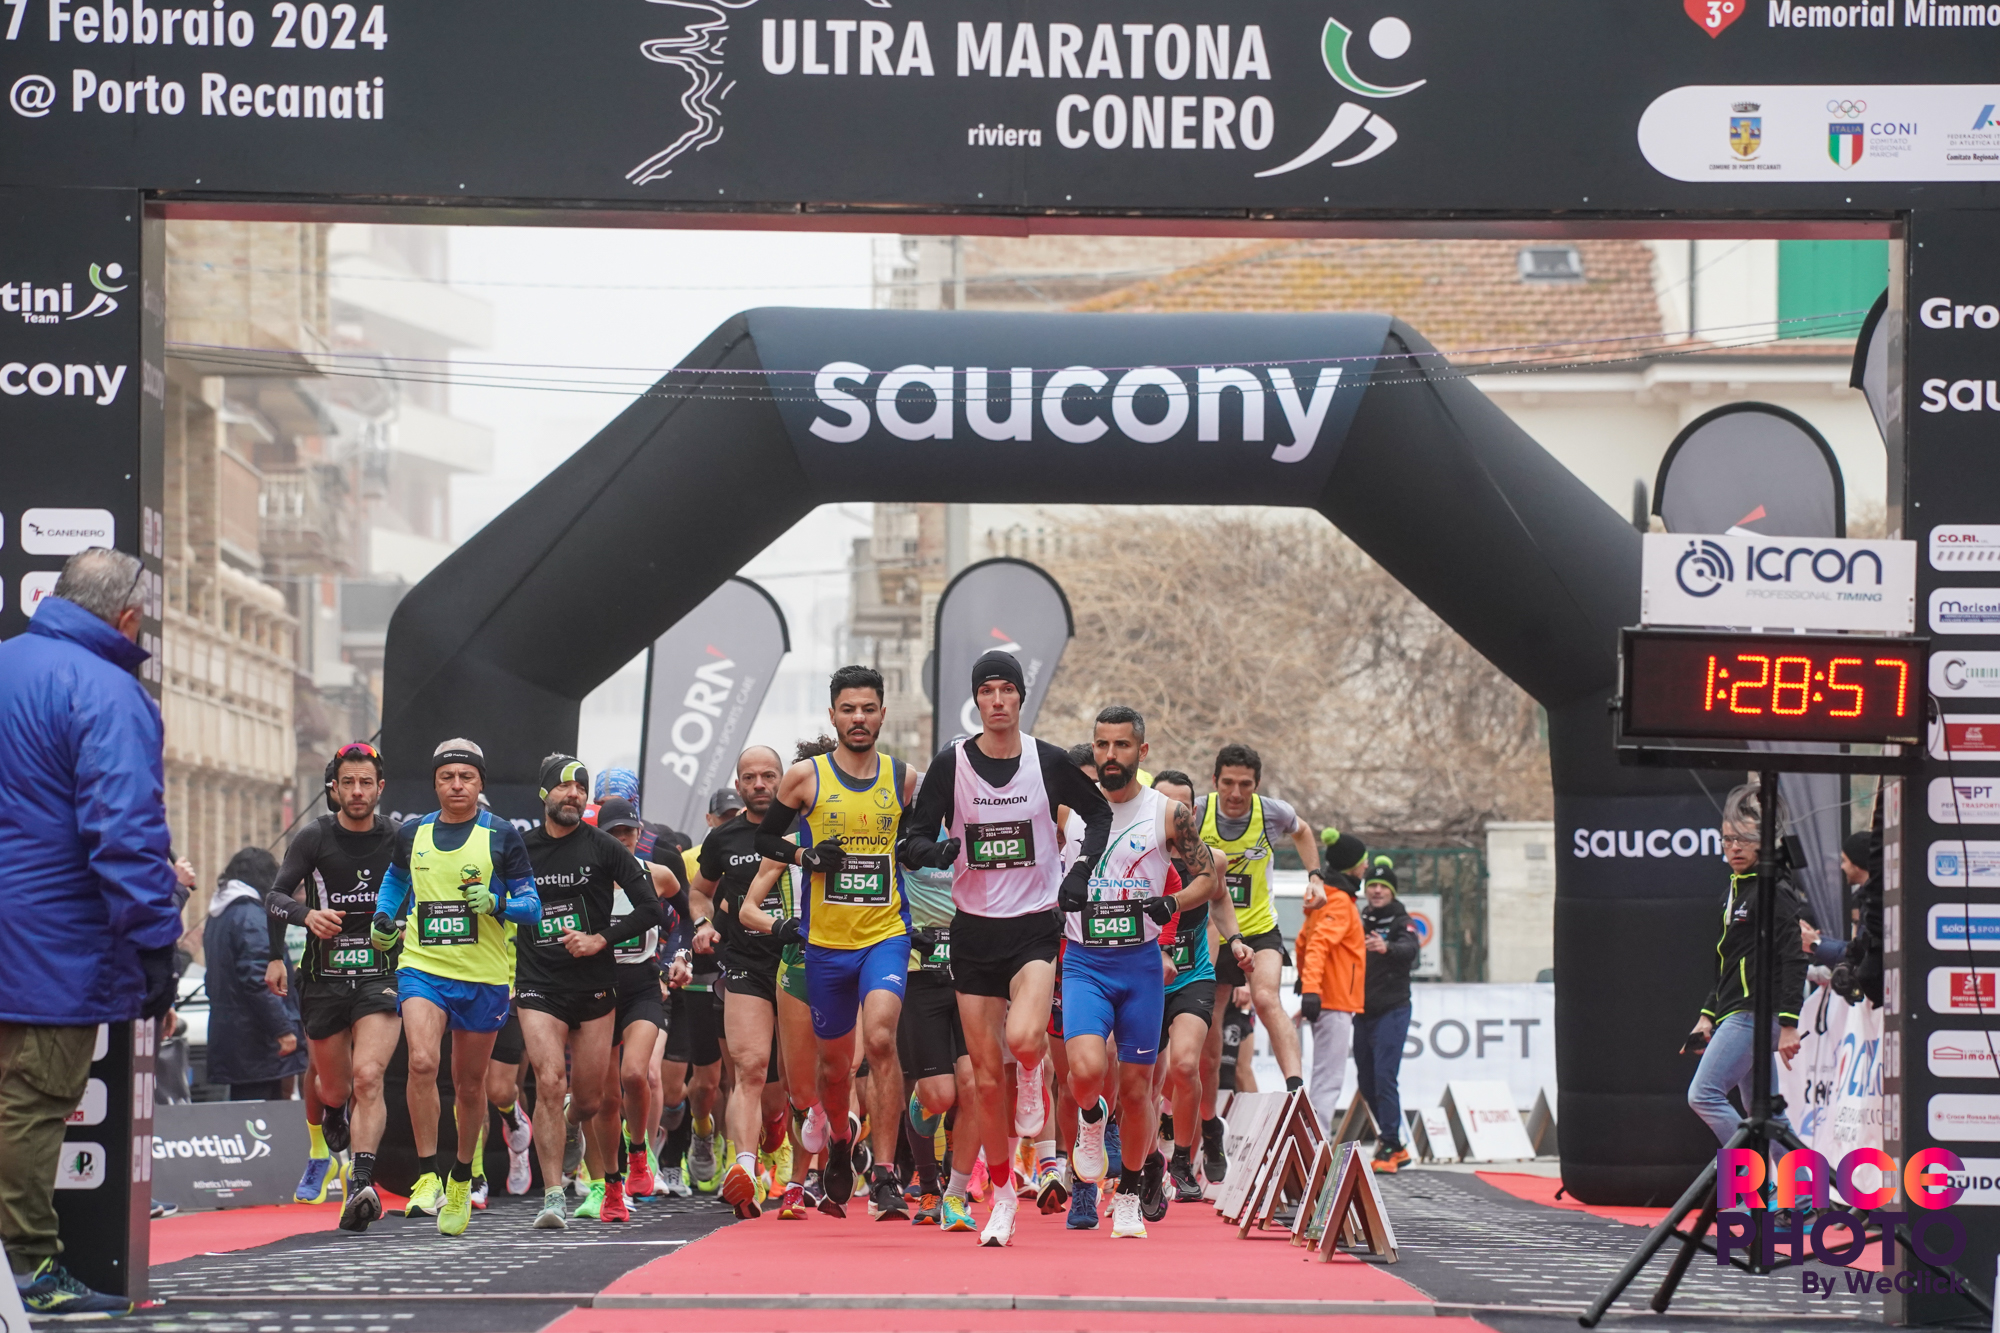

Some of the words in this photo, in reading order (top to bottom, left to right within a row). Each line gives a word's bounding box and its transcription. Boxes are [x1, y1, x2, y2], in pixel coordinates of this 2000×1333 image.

[1769, 0, 1895, 28] Memorial
[1904, 0, 2000, 27] Mimmo
[49, 0, 255, 48] Febbraio
[271, 3, 388, 50] 2024
[761, 19, 935, 77] ULTRA
[956, 21, 1272, 81] MARATONA
[10, 74, 56, 118] @
[72, 69, 185, 116] Porto
[201, 73, 384, 119] Recanati
[968, 124, 1041, 147] riviera
[1055, 94, 1275, 150] CONERO
[1831, 125, 1862, 133] ITALIA
[1870, 122, 1918, 136] CONI
[21, 312, 59, 323] Team
[1920, 297, 2000, 329] Gro
[0, 362, 127, 406] cony
[808, 361, 1344, 464] saucony
[47, 529, 105, 538] CANENERO
[1746, 589, 1833, 601] PROFESSIONAL
[1836, 591, 1883, 603] TIMING
[1704, 654, 1909, 718] 1:28:57
[660, 644, 736, 787] BORN
[718, 703, 744, 746] SPORTS
[735, 675, 757, 706] CARE
[973, 795, 1028, 806] SALOMON
[1973, 786, 1993, 798] PT
[980, 840, 1020, 857] 402
[1573, 828, 1729, 863] saucon
[729, 851, 764, 867] Grot
[840, 873, 878, 890] 554
[930, 871, 954, 879] HOKA
[330, 891, 378, 904] Grotti
[428, 917, 465, 933] 405
[541, 915, 575, 933] 516
[1094, 917, 1131, 934] 549
[333, 949, 369, 964] 449
[152, 1133, 246, 1160] Grottini
[219, 1155, 242, 1164] Team
